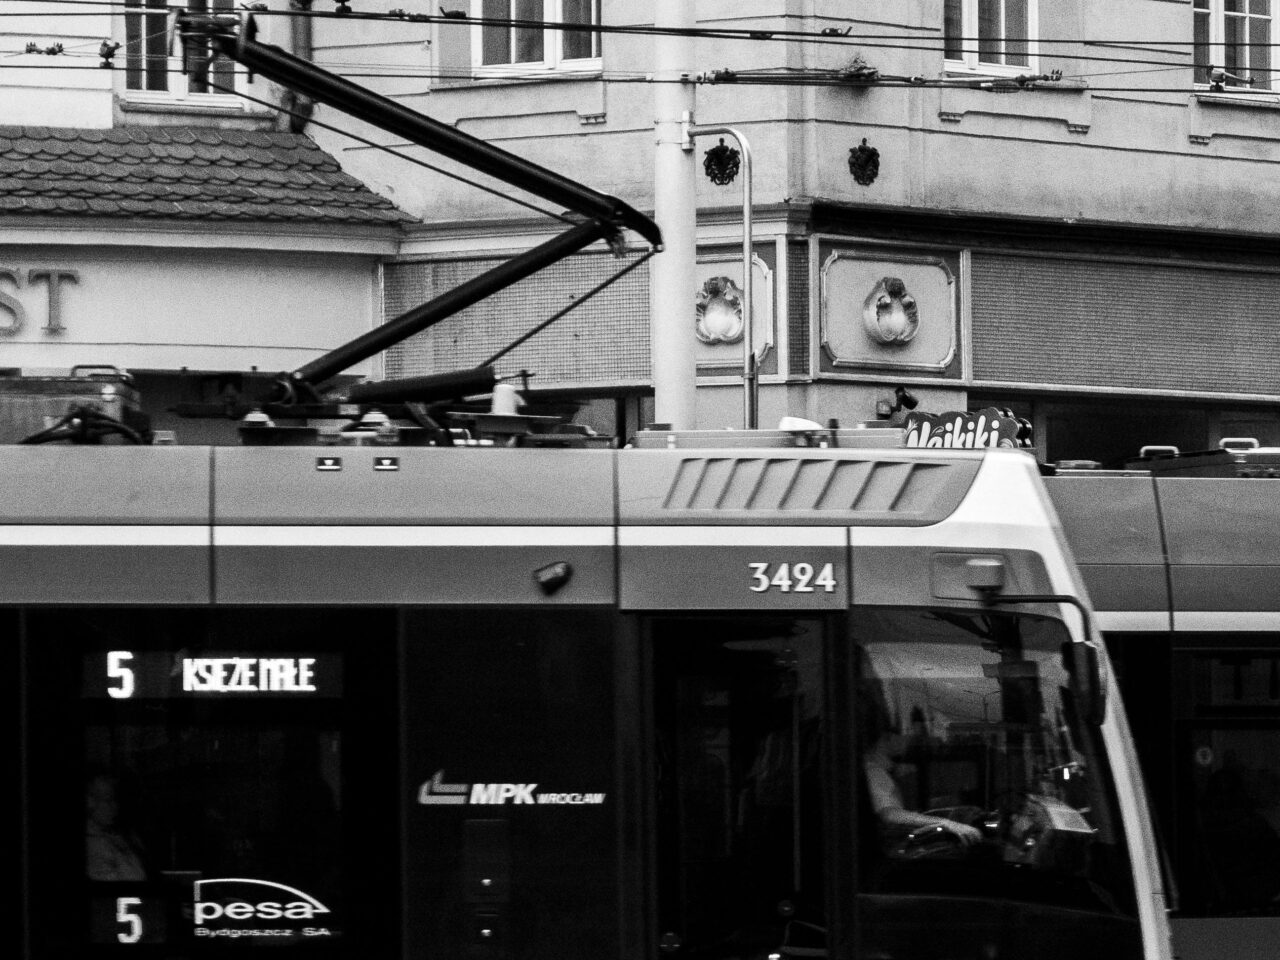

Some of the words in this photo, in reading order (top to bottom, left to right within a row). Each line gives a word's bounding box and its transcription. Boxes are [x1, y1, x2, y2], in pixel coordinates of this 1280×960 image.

[748, 562, 837, 592] 3424
[107, 650, 135, 699] 5
[469, 783, 538, 804] MPK
[116, 897, 143, 944] 5
[194, 902, 314, 925] pesa
[194, 927, 293, 938] Bydgoszcz
[301, 927, 332, 936] SA
